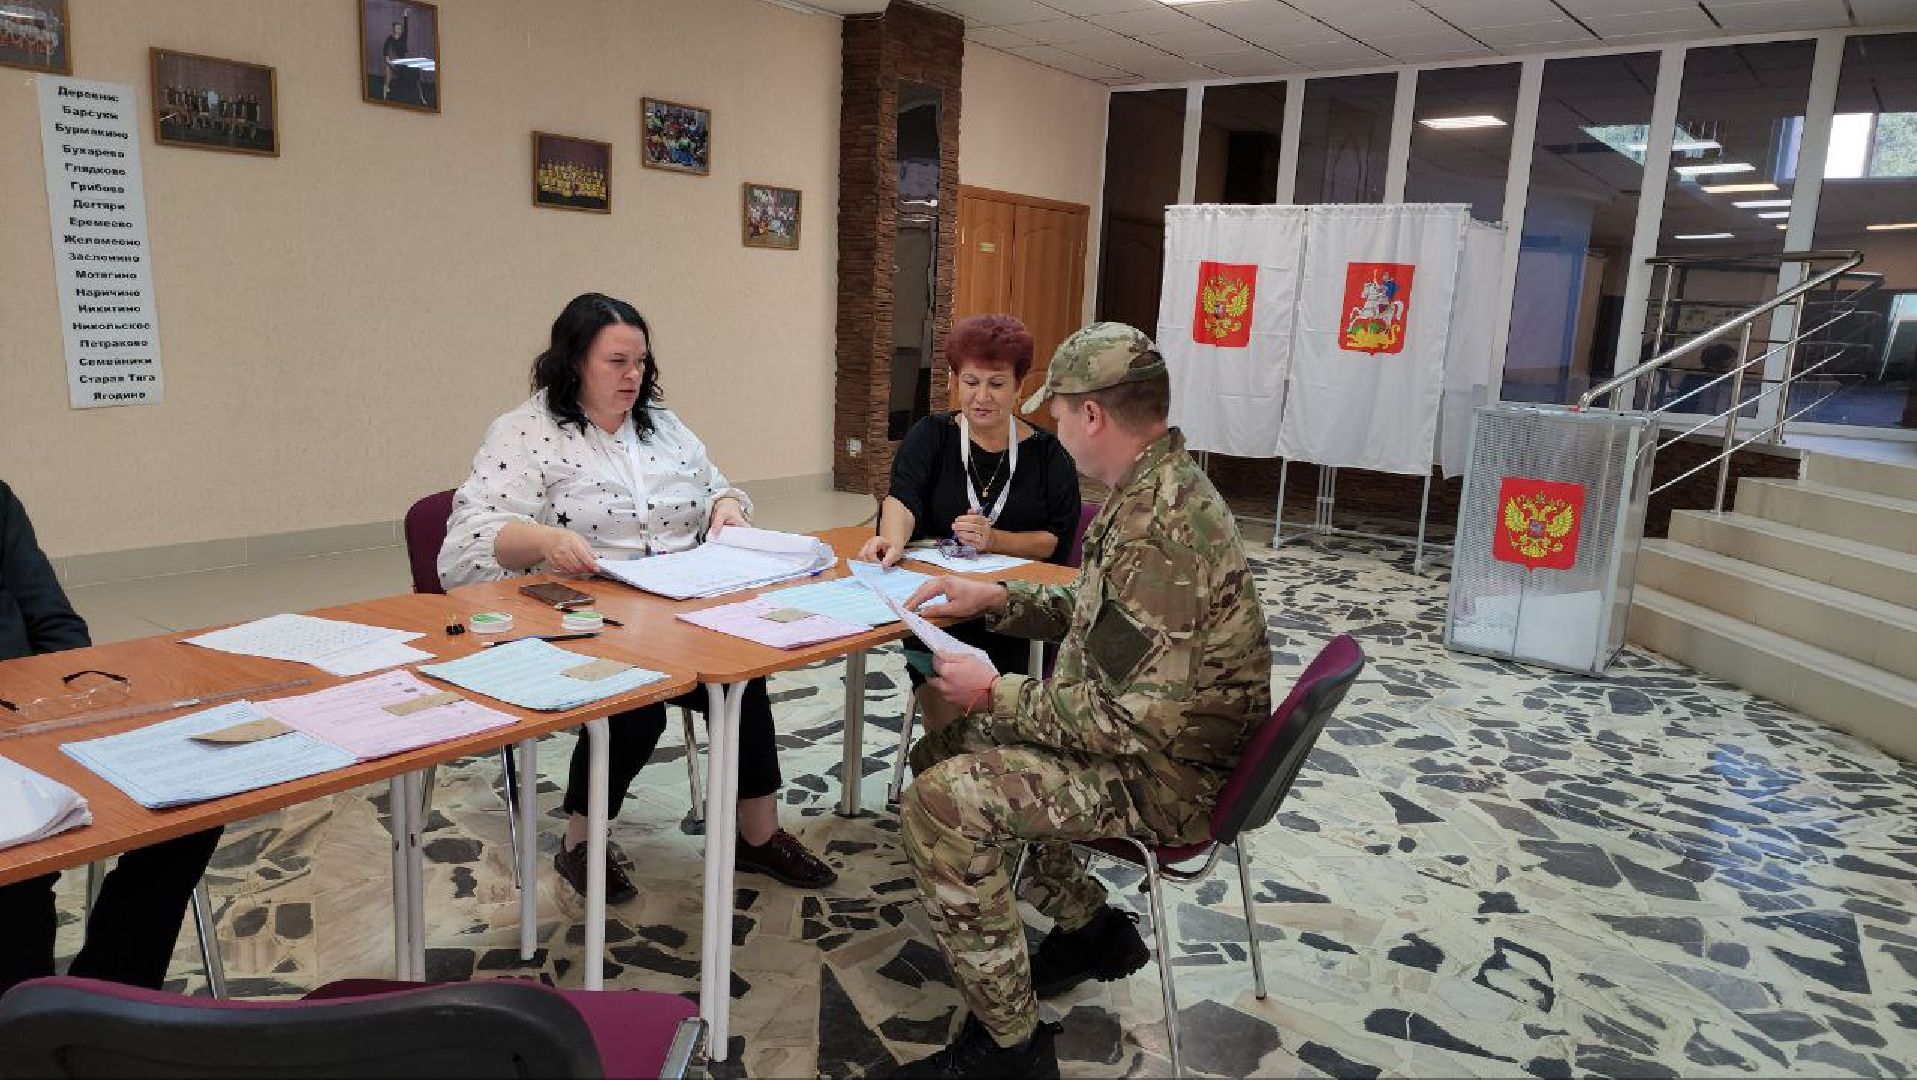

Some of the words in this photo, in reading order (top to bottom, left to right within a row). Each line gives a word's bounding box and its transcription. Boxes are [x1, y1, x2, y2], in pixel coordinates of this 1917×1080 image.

[57, 85, 120, 102] Деревни:
[62, 105, 119, 120] Барсуки
[78, 304, 141, 314] Никитино
[72, 322, 151, 330] Никольское
[79, 374, 125, 384] Старая
[127, 373, 156, 382] Тяга
